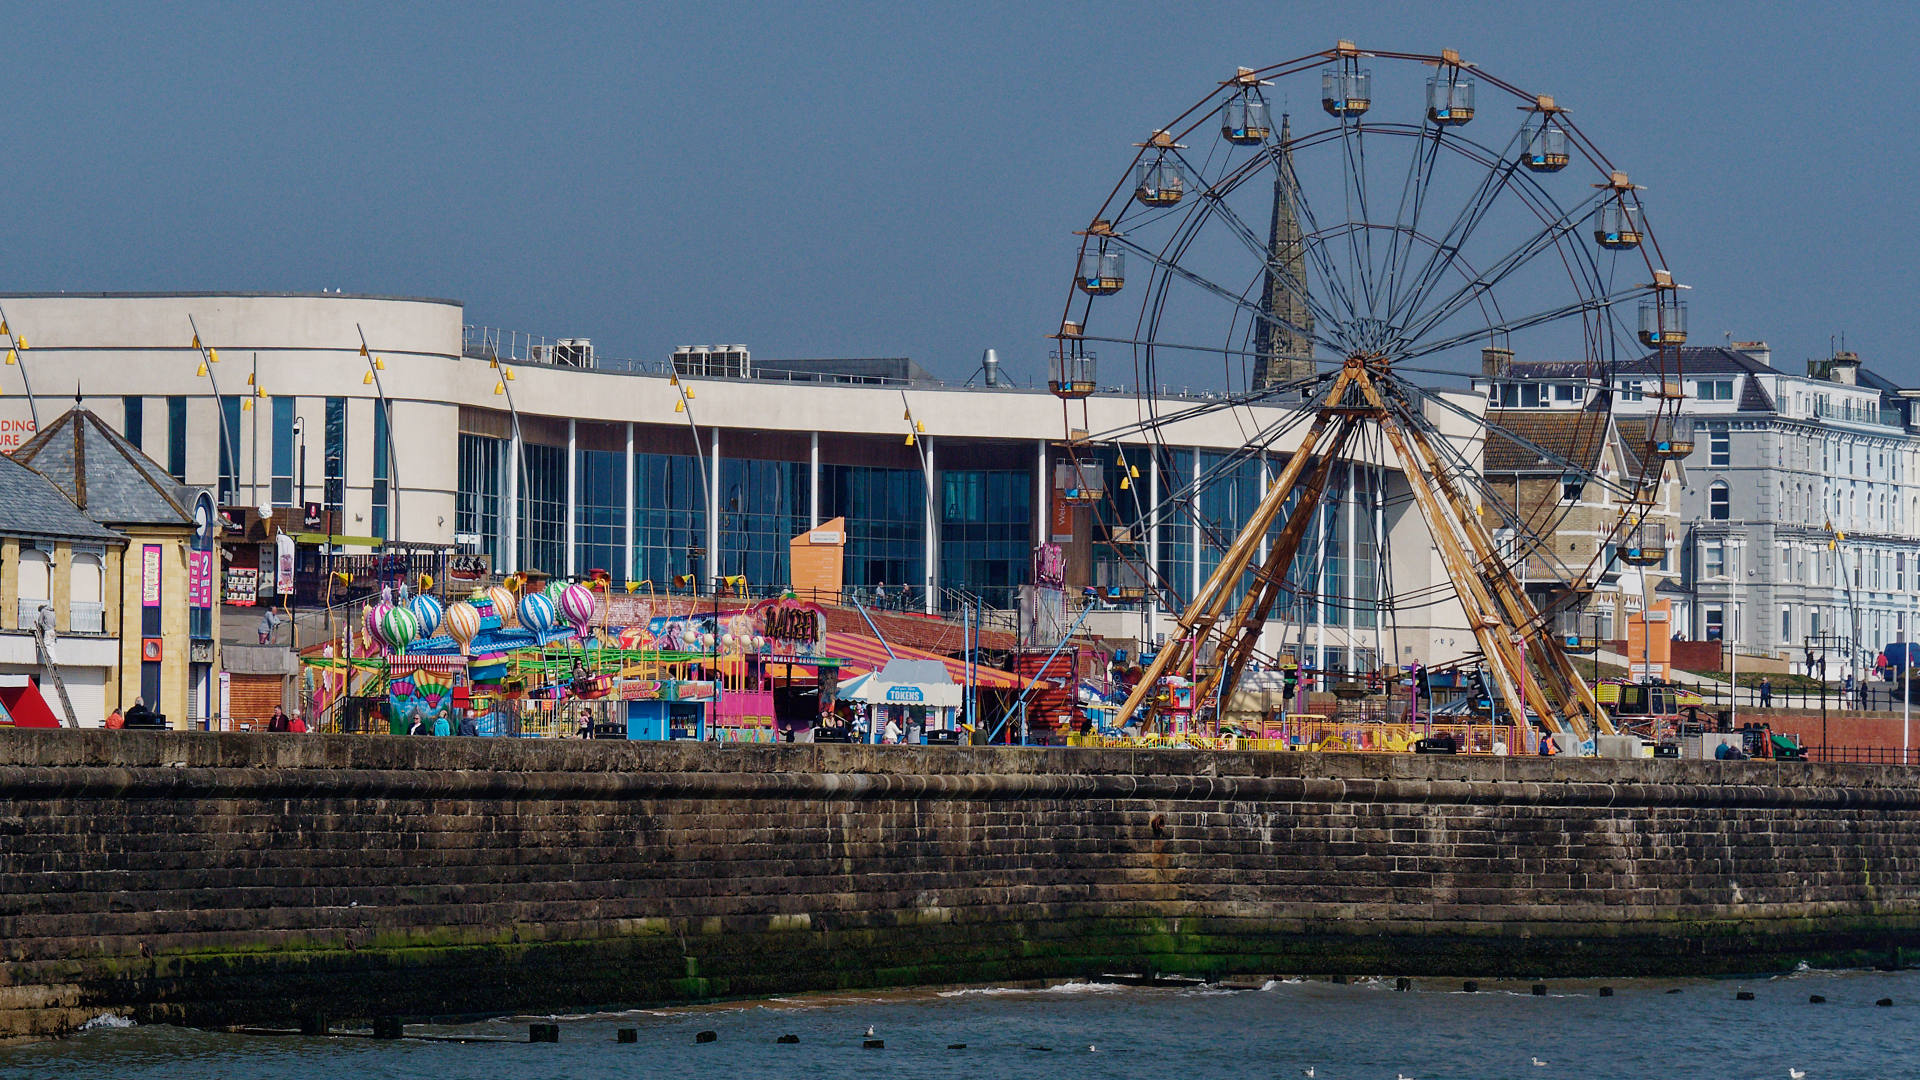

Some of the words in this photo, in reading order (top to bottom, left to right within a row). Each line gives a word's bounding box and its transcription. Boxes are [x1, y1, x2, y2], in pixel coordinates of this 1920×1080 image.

[1, 420, 36, 431] DING
[1057, 503, 1066, 526] Welc
[890, 691, 920, 700] TOKENS
